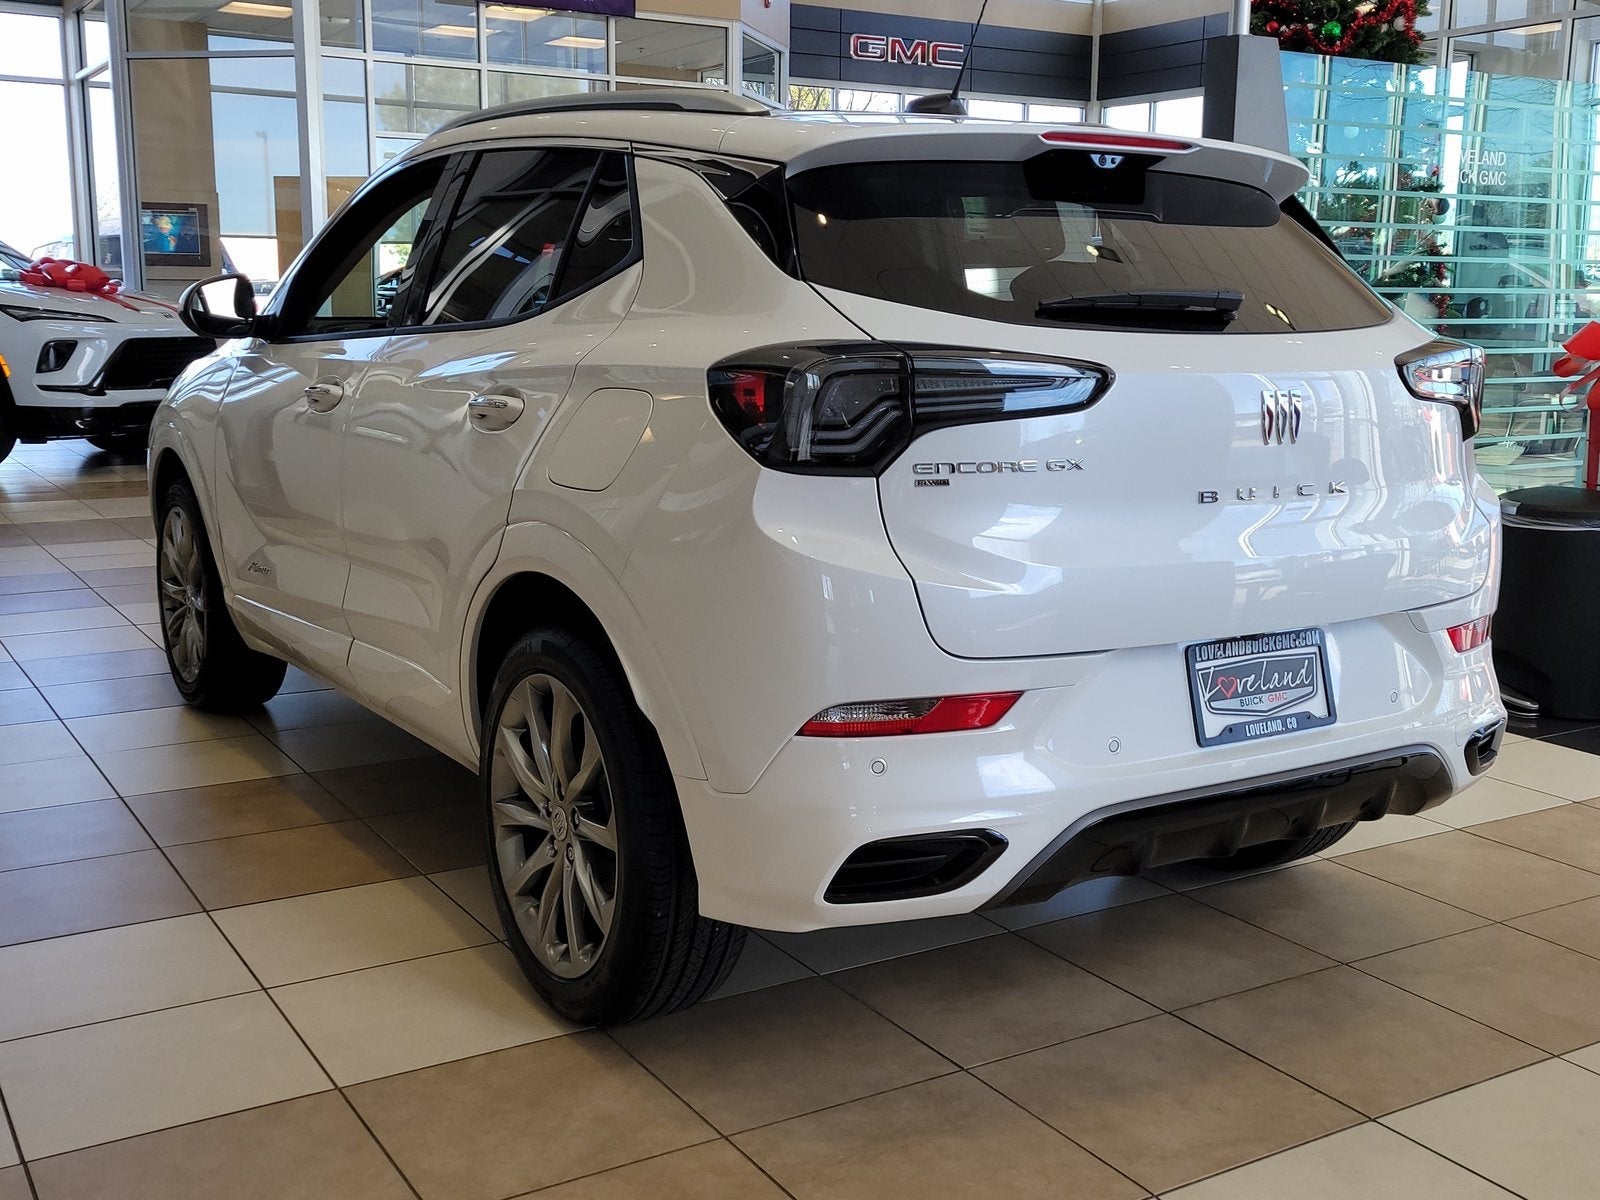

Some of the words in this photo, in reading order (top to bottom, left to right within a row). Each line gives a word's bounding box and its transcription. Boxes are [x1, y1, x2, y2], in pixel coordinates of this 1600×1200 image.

[850, 33, 964, 69] GMC
[1459, 149, 1506, 166] VELAND
[1479, 170, 1507, 186] GMC
[912, 460, 1038, 475] ENCORE
[1046, 457, 1085, 471] GX
[1198, 481, 1346, 504] BUICK
[1239, 695, 1264, 708] BUICK
[1267, 692, 1288, 704] GMC
[1286, 717, 1298, 730] CO
